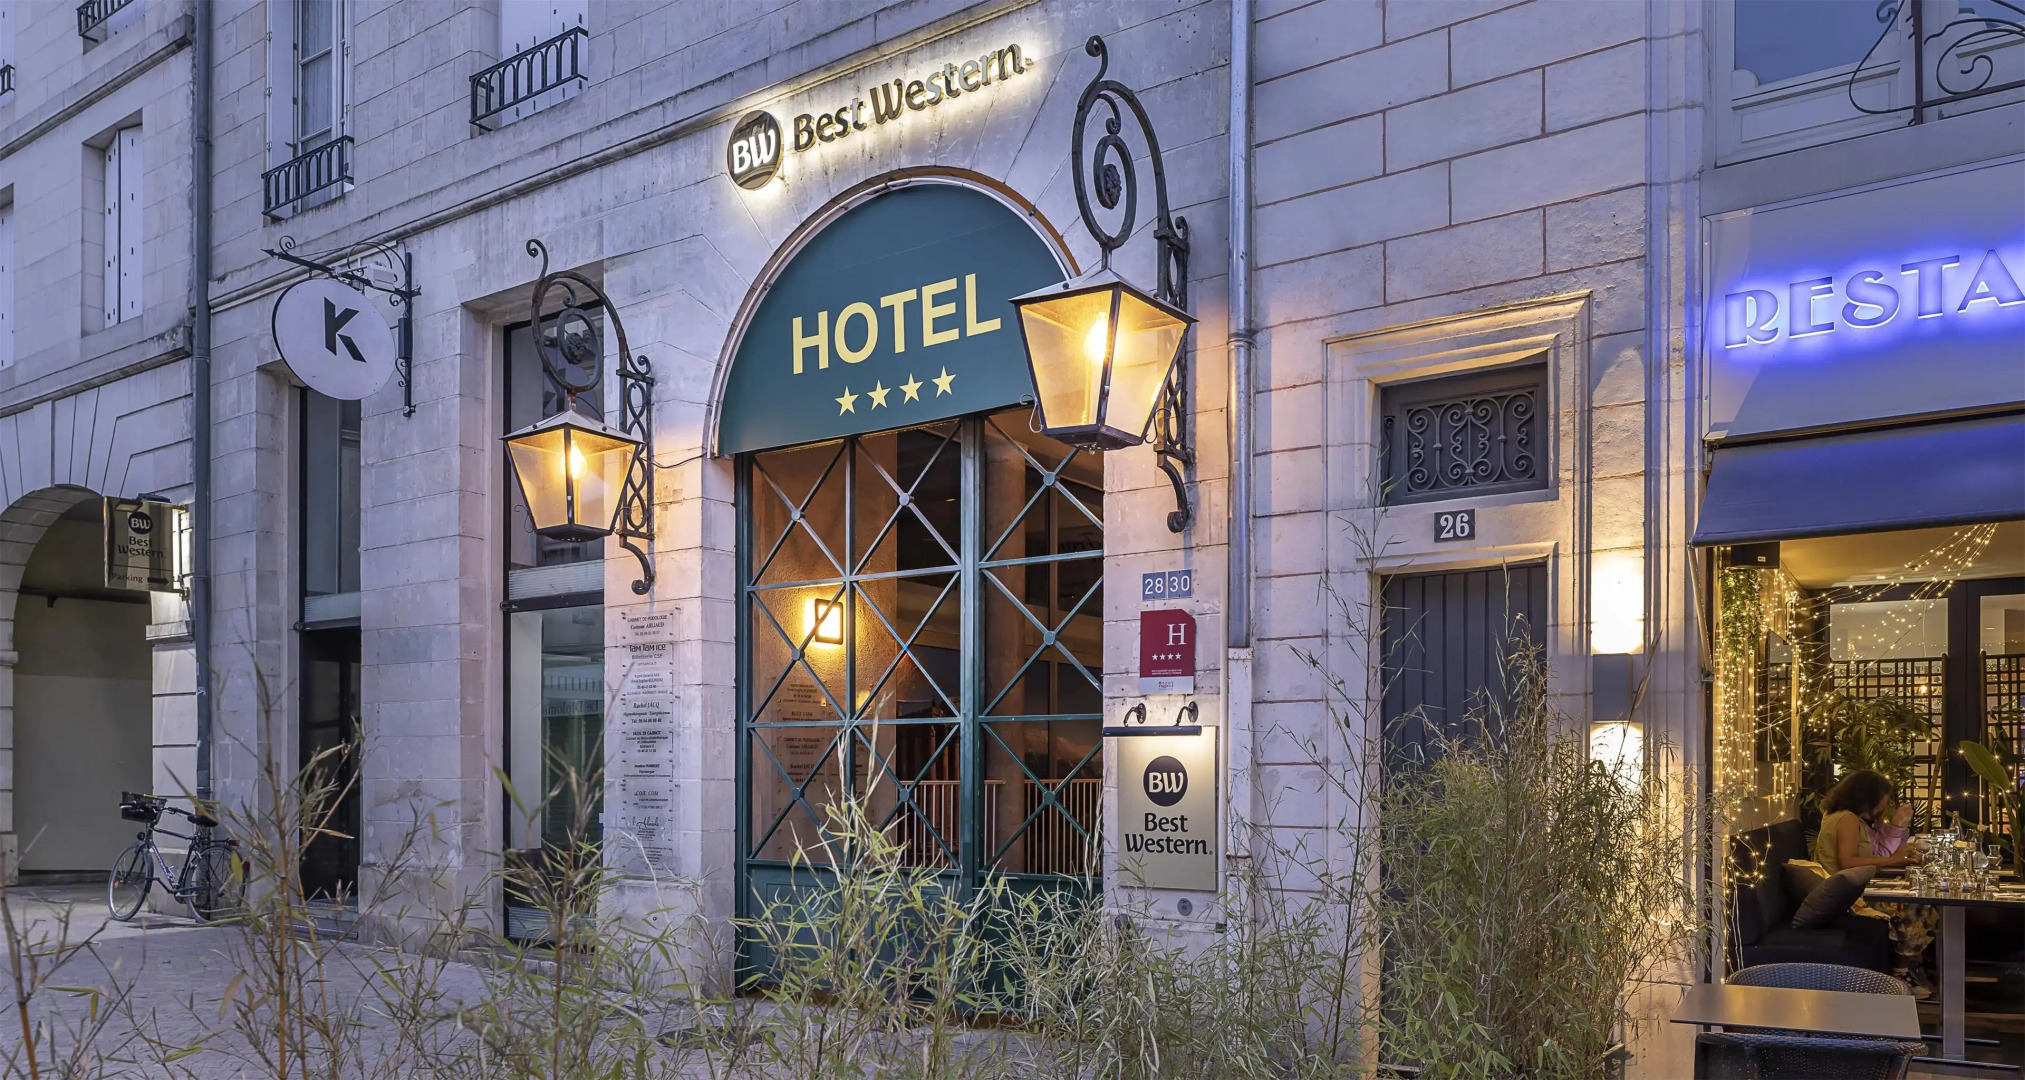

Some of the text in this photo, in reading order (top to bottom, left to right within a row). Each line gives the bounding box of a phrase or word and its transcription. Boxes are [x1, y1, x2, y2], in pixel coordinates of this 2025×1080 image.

[793, 98, 867, 152] Best
[732, 128, 776, 174] BW
[323, 296, 367, 363] K
[792, 273, 1002, 375] HOTEL
[131, 517, 152, 530] BW
[1440, 512, 1470, 539] 26
[118, 544, 164, 558] Western
[129, 536, 153, 547] Best
[111, 573, 144, 583] Parking
[1144, 575, 1190, 595] 28 30
[1166, 622, 1187, 646] H
[1148, 771, 1184, 794] BW
[1144, 812, 1189, 833] Best
